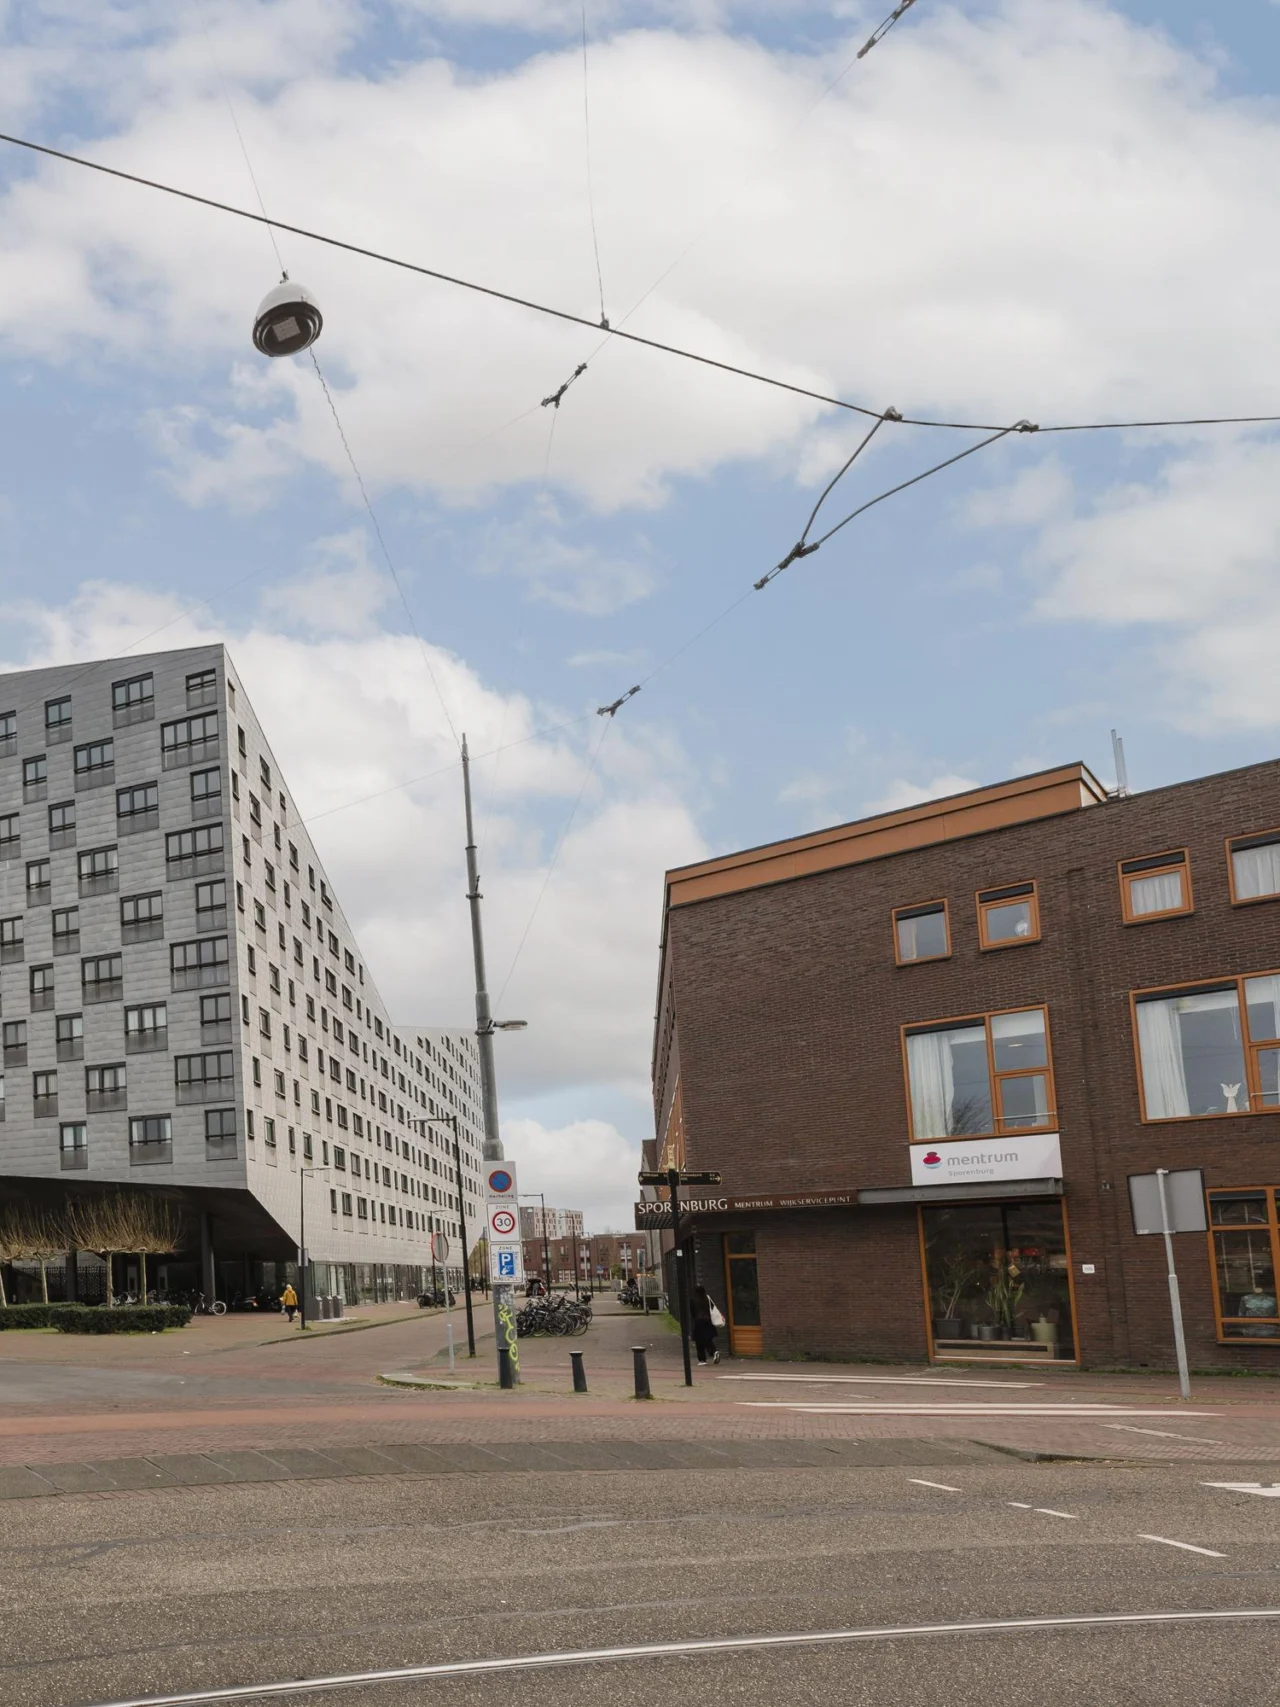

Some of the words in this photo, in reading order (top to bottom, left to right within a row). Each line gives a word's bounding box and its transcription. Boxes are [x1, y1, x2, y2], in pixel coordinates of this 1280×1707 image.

[947, 1152, 1018, 1166] mentrum
[948, 1168, 994, 1177] Sporenburg
[638, 1198, 728, 1214] SPORNBURG
[734, 1200, 773, 1208] MENTRUM
[780, 1196, 851, 1206] WIJKSERVICEPUNT
[496, 1217, 512, 1227] 30
[501, 1253, 511, 1266] P
